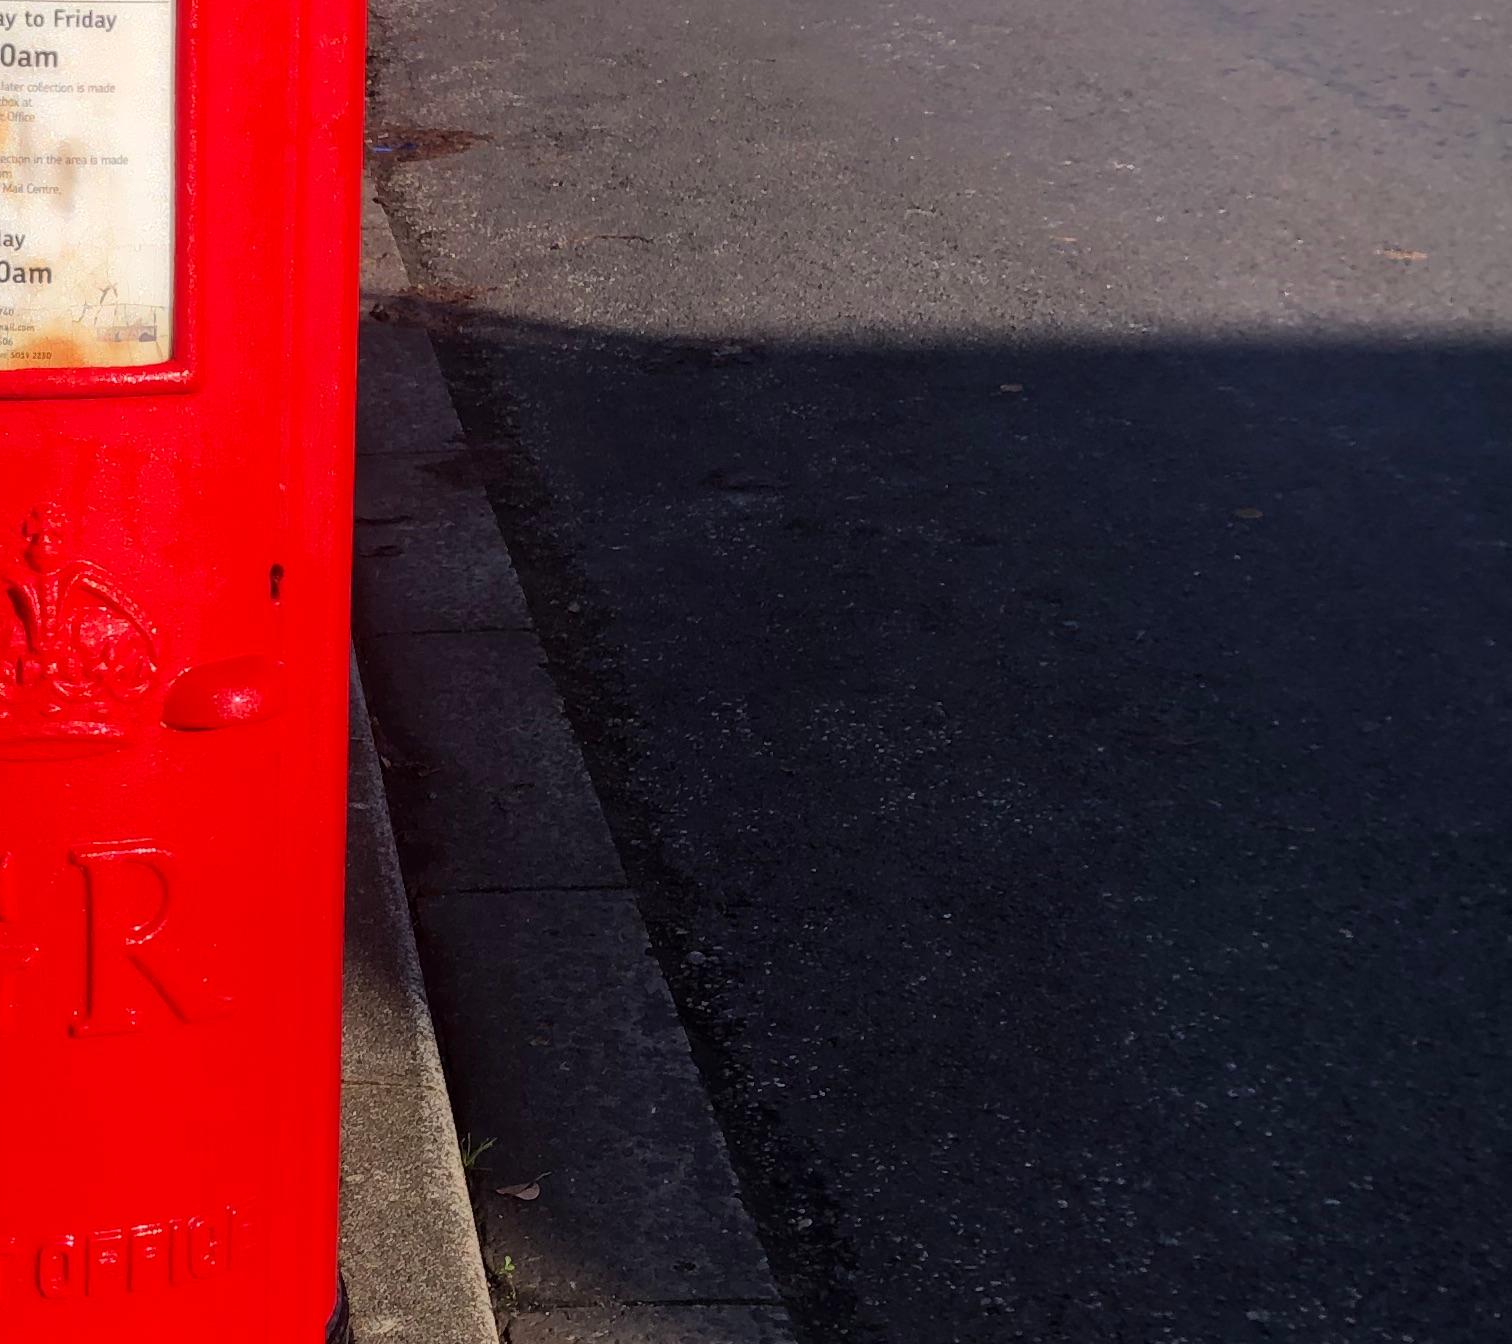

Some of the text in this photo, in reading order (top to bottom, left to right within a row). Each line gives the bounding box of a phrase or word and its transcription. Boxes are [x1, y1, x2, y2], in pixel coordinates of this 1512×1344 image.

[25, 10, 46, 29] to
[53, 8, 118, 33] Friday
[26, 82, 74, 94] collection
[76, 83, 85, 93] is
[87, 82, 116, 94] made
[21, 97, 33, 108] at
[6, 111, 36, 123] Office
[33, 154, 43, 164] in
[45, 154, 63, 165] the
[64, 155, 88, 166] area
[89, 155, 98, 165] is
[100, 154, 129, 166] made
[2, 182, 24, 193] Mail
